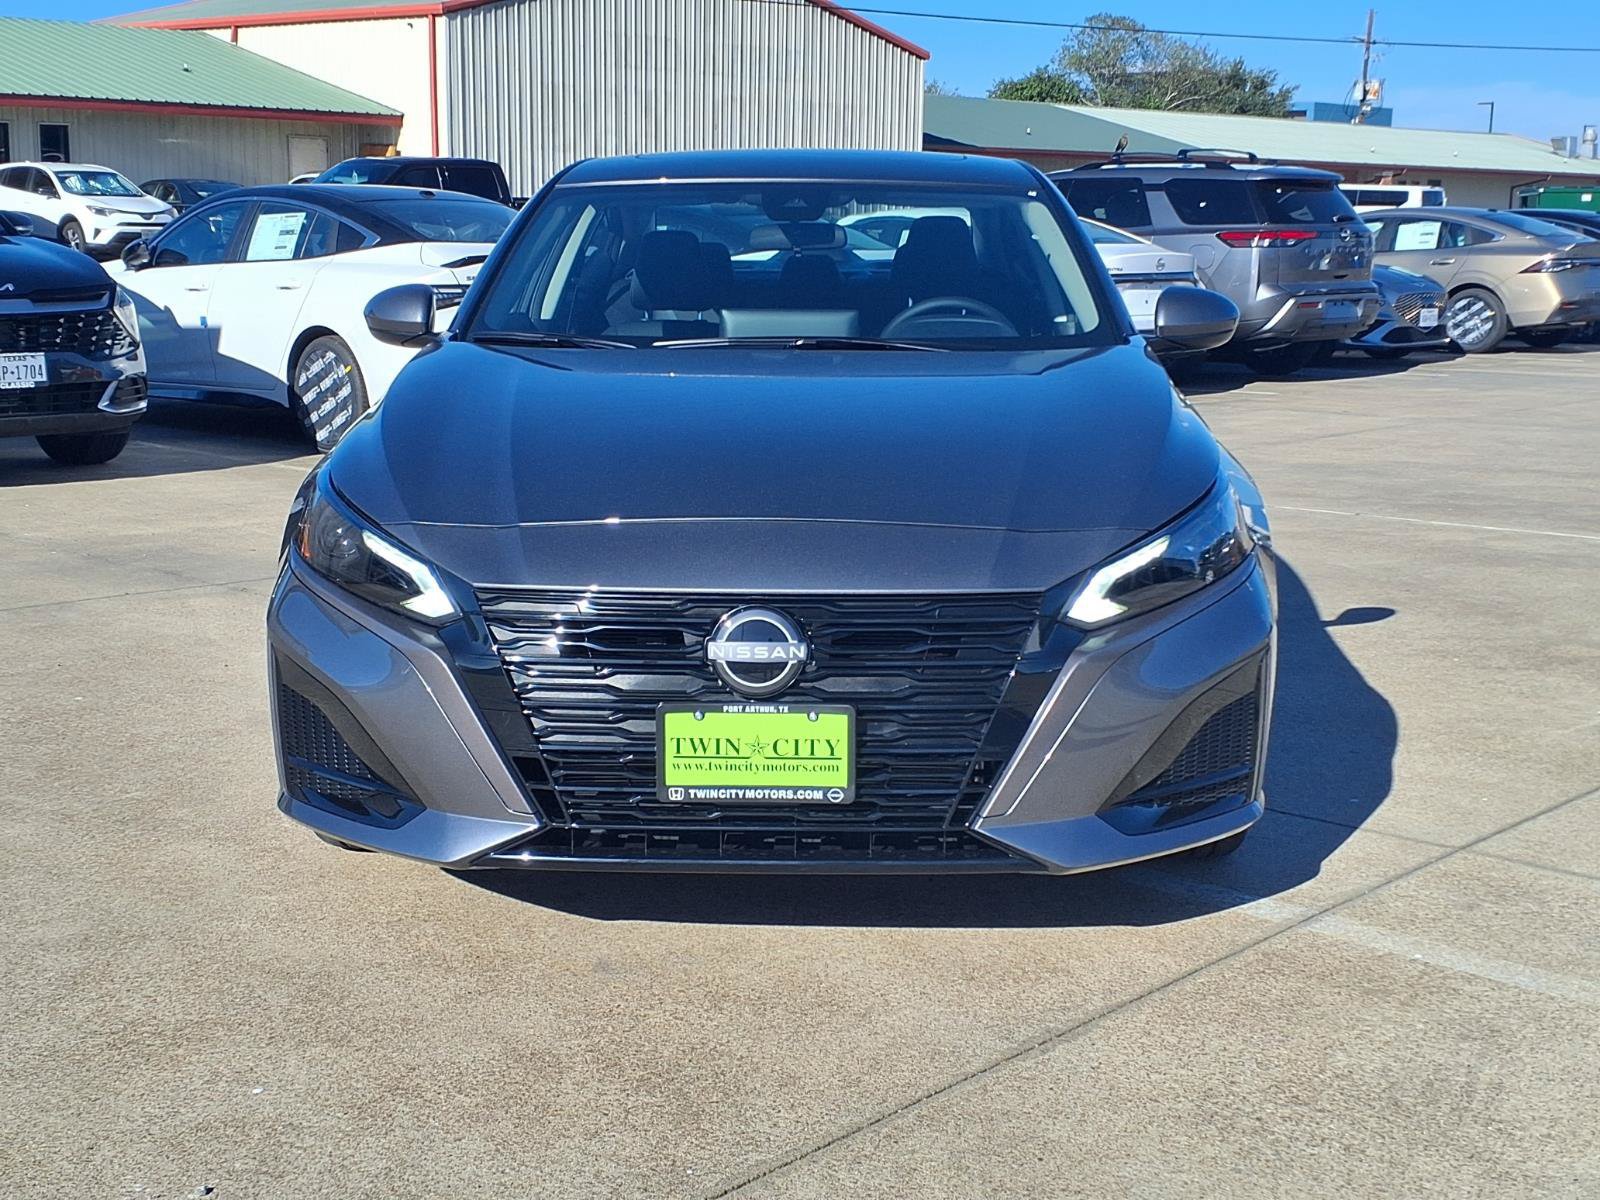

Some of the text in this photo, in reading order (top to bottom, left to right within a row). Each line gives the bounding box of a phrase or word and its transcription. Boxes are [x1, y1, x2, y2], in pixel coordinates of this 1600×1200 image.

[709, 645, 805, 659] NISSAN
[722, 705, 789, 713] PORT ARTHUR, TX
[670, 737, 840, 757] TWIN CITY
[672, 760, 840, 775] www.twincitymotors.com
[688, 788, 824, 800] TWINCITYMOTORS.COM
